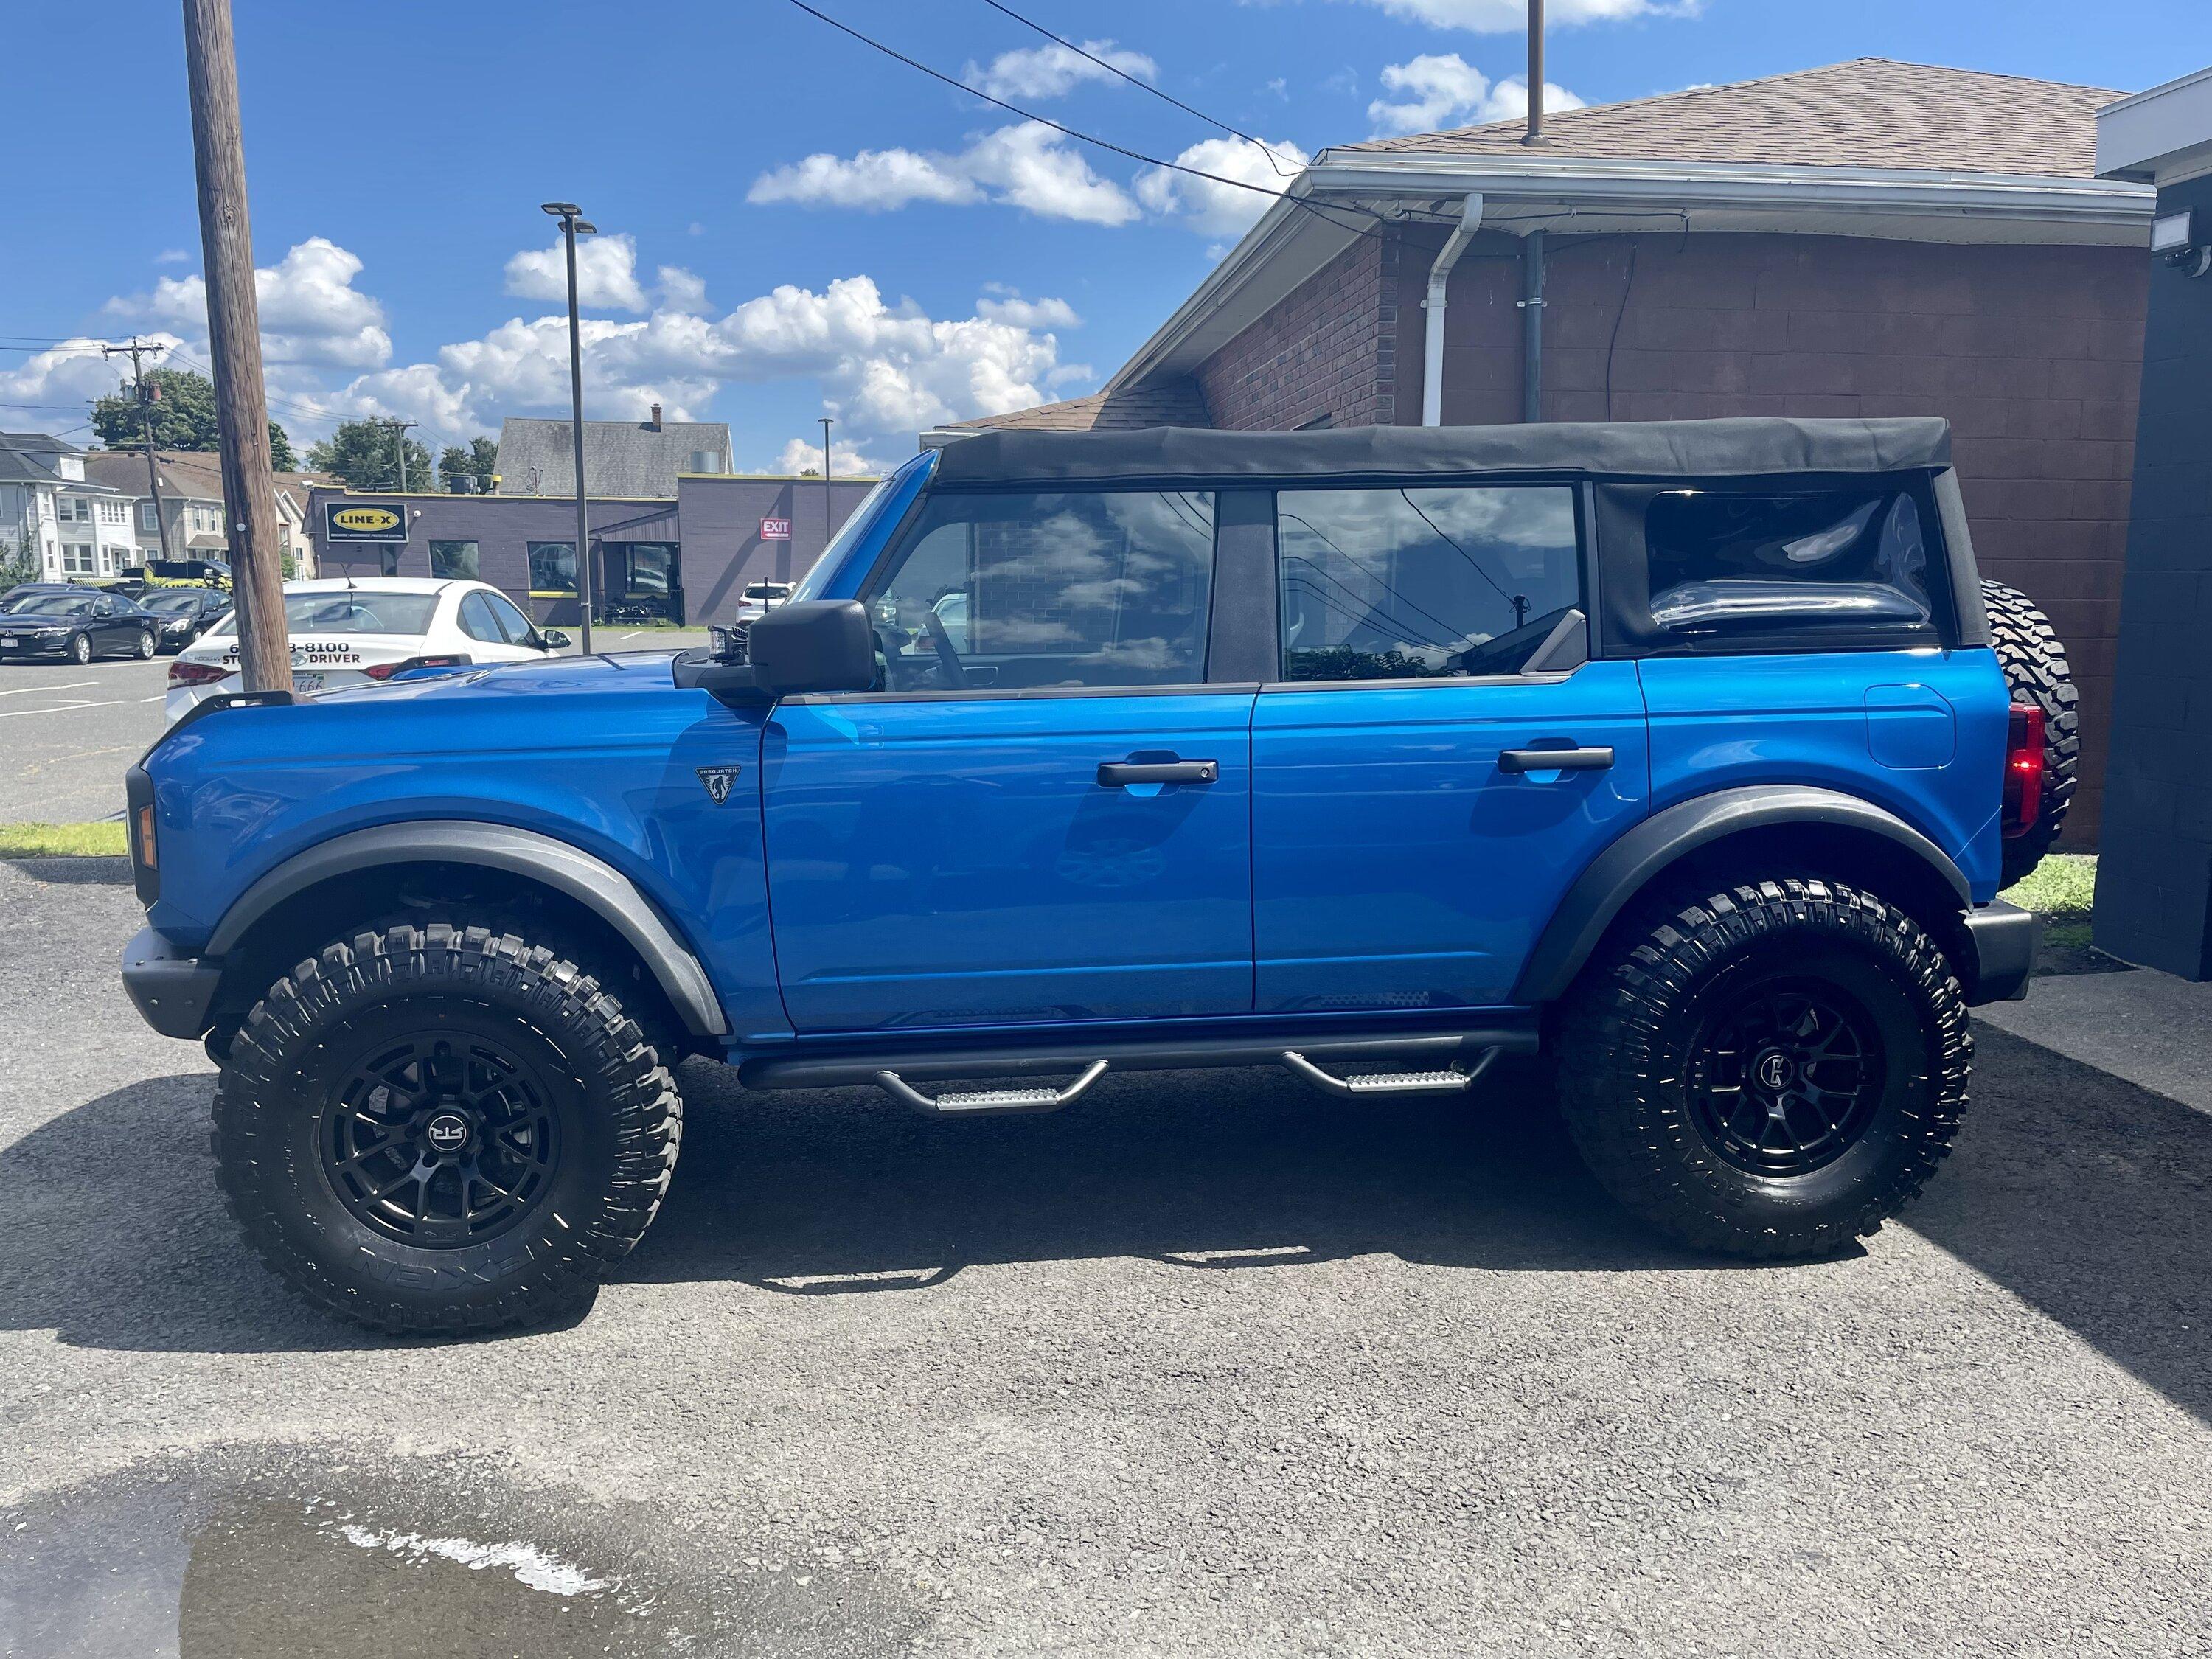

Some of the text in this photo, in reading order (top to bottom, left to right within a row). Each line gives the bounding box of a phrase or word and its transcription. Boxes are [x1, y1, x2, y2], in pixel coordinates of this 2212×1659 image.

[340, 515, 391, 524] LINE-X
[763, 521, 789, 532] EXIT
[310, 653, 361, 664] DRIVER
